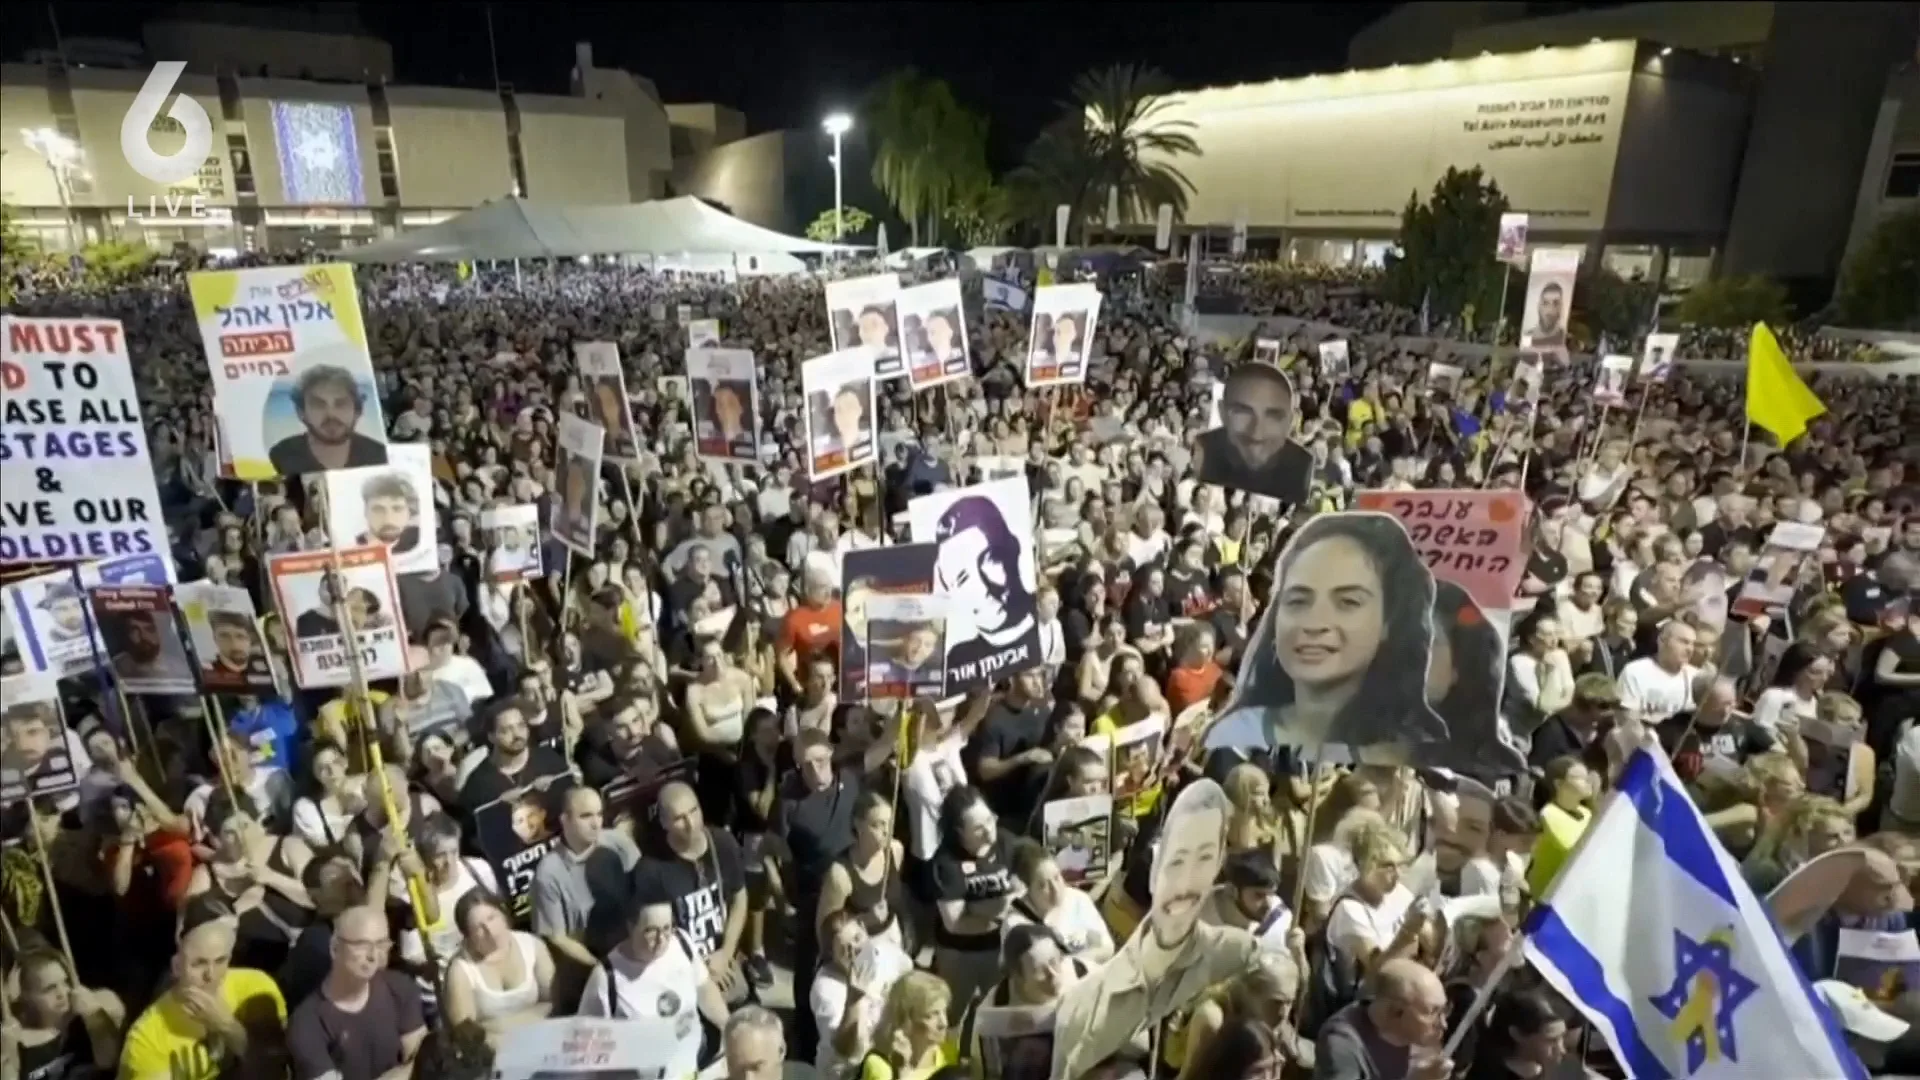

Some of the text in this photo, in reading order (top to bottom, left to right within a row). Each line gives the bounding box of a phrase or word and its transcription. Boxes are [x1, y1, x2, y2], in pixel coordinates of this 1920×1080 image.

[1463, 112, 1606, 132] Tel Aviv Museum of Art
[214, 300, 334, 328] אלון אהל
[8, 323, 119, 354] MUST
[223, 333, 290, 354] הביתה
[42, 360, 98, 390] TO
[224, 360, 290, 380] בחיים
[5, 398, 139, 424] ASE ALL
[35, 466, 64, 493] &
[73, 498, 149, 524] OUR
[1417, 549, 1511, 574] היחיד
[950, 643, 1030, 683] אבינתן אור
